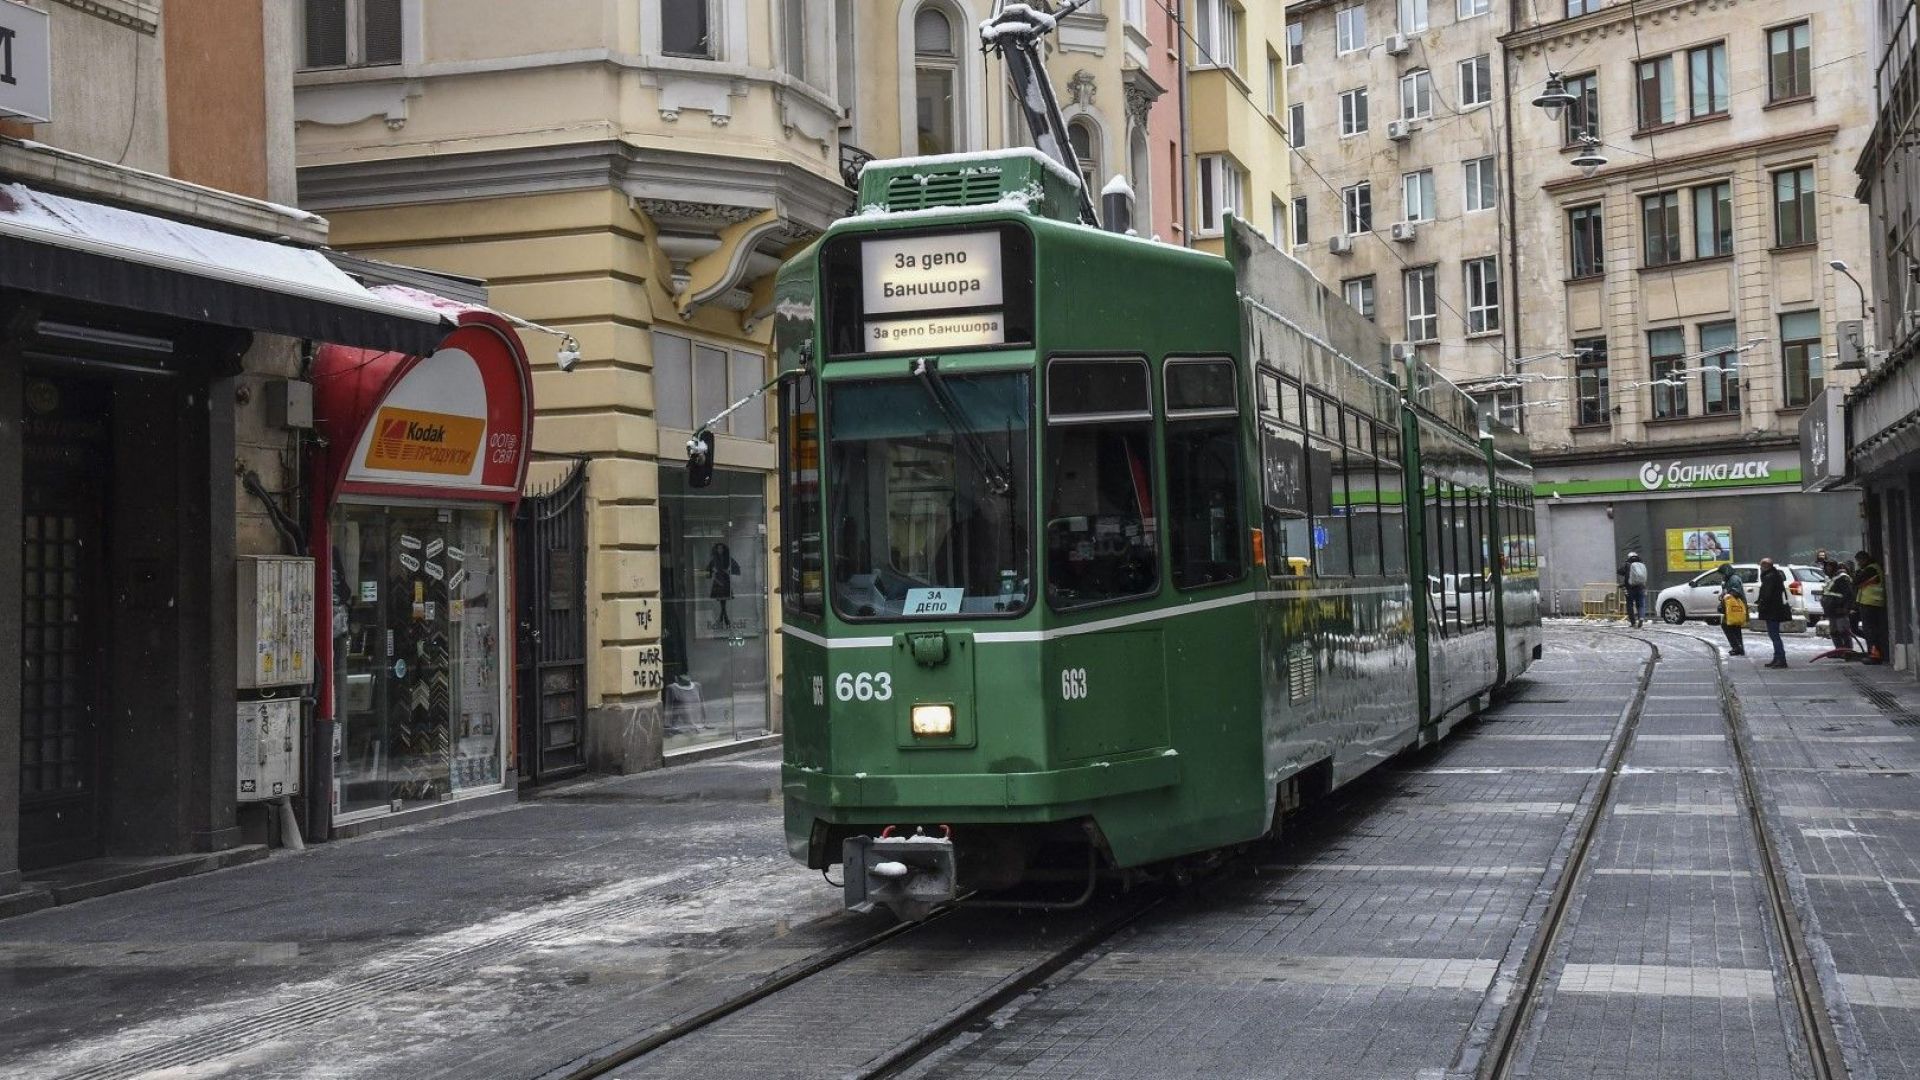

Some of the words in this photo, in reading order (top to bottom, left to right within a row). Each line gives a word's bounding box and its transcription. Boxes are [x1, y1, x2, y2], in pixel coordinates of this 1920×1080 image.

[895, 253, 916, 269] За
[921, 251, 967, 270] депо
[883, 279, 981, 298] Банишора
[873, 327, 889, 339] За
[893, 325, 925, 341] депо
[928, 321, 998, 335] Банишора
[406, 421, 447, 443] Kodak
[416, 445, 472, 465] ПРОДУКТИ
[492, 449, 517, 464] СВЯТ
[1667, 461, 1728, 483] банка
[1729, 461, 1770, 480] ДСК
[927, 590, 942, 601] ЗА
[916, 601, 948, 613] ДЕПО
[835, 671, 892, 701] 663
[1061, 667, 1088, 700] 663
